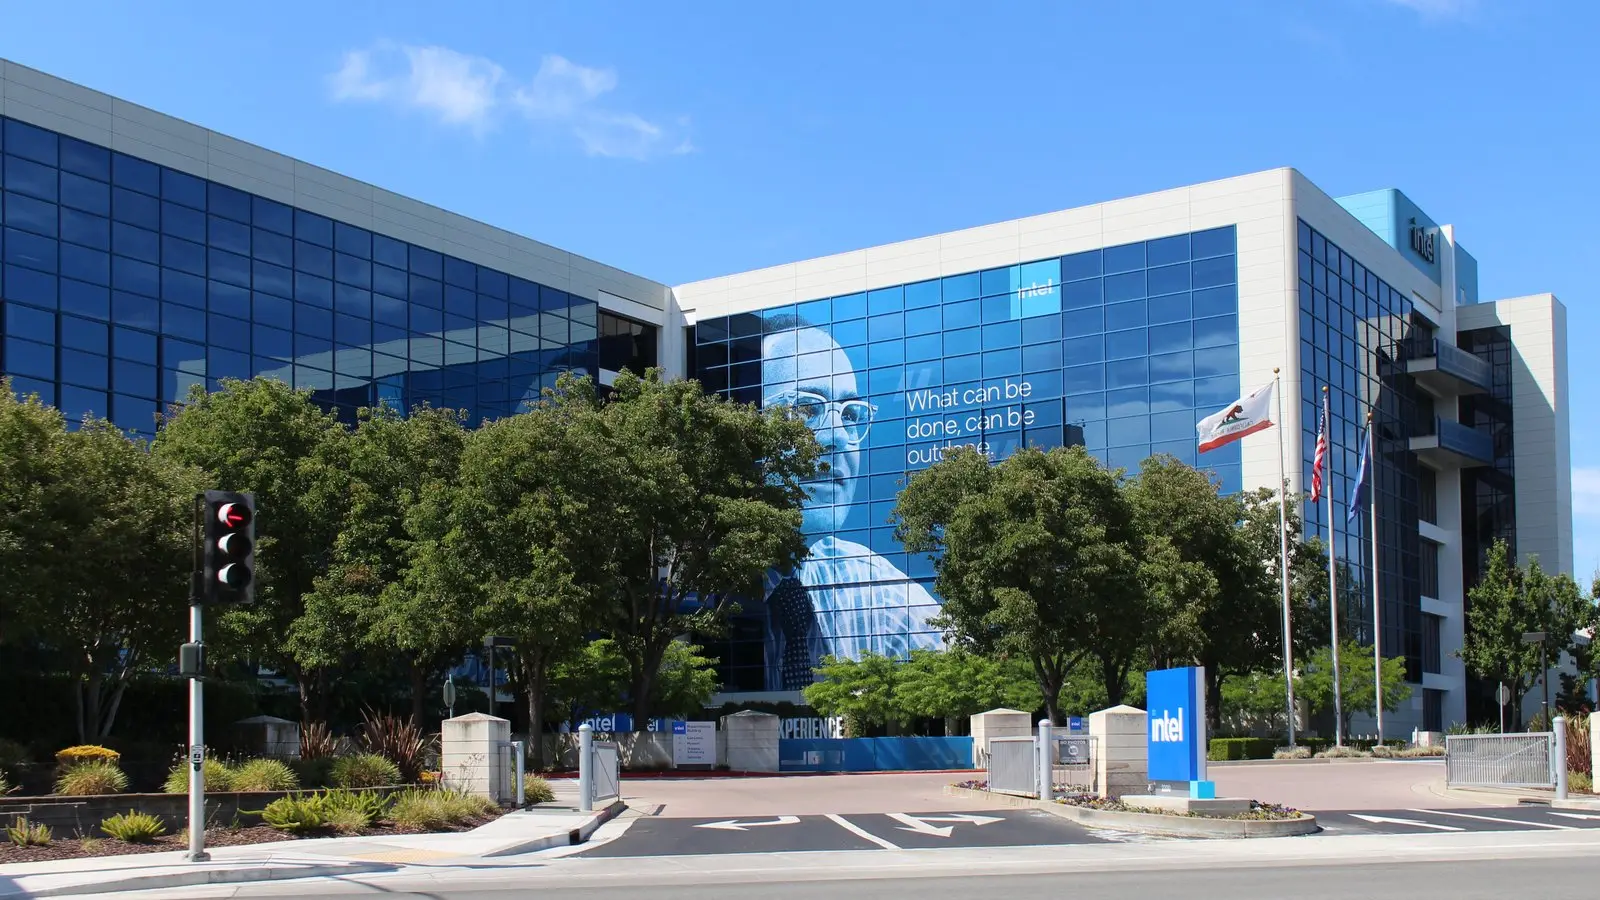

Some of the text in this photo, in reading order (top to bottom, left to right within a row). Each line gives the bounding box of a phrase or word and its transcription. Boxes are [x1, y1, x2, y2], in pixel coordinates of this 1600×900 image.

[1017, 278, 1053, 300] intel
[906, 379, 1032, 412] What can be
[907, 406, 1035, 439] done, can be
[907, 440, 994, 465] outde.
[582, 713, 616, 732] ntel
[778, 716, 844, 740] XPERIENCE
[1152, 707, 1184, 742] intel
